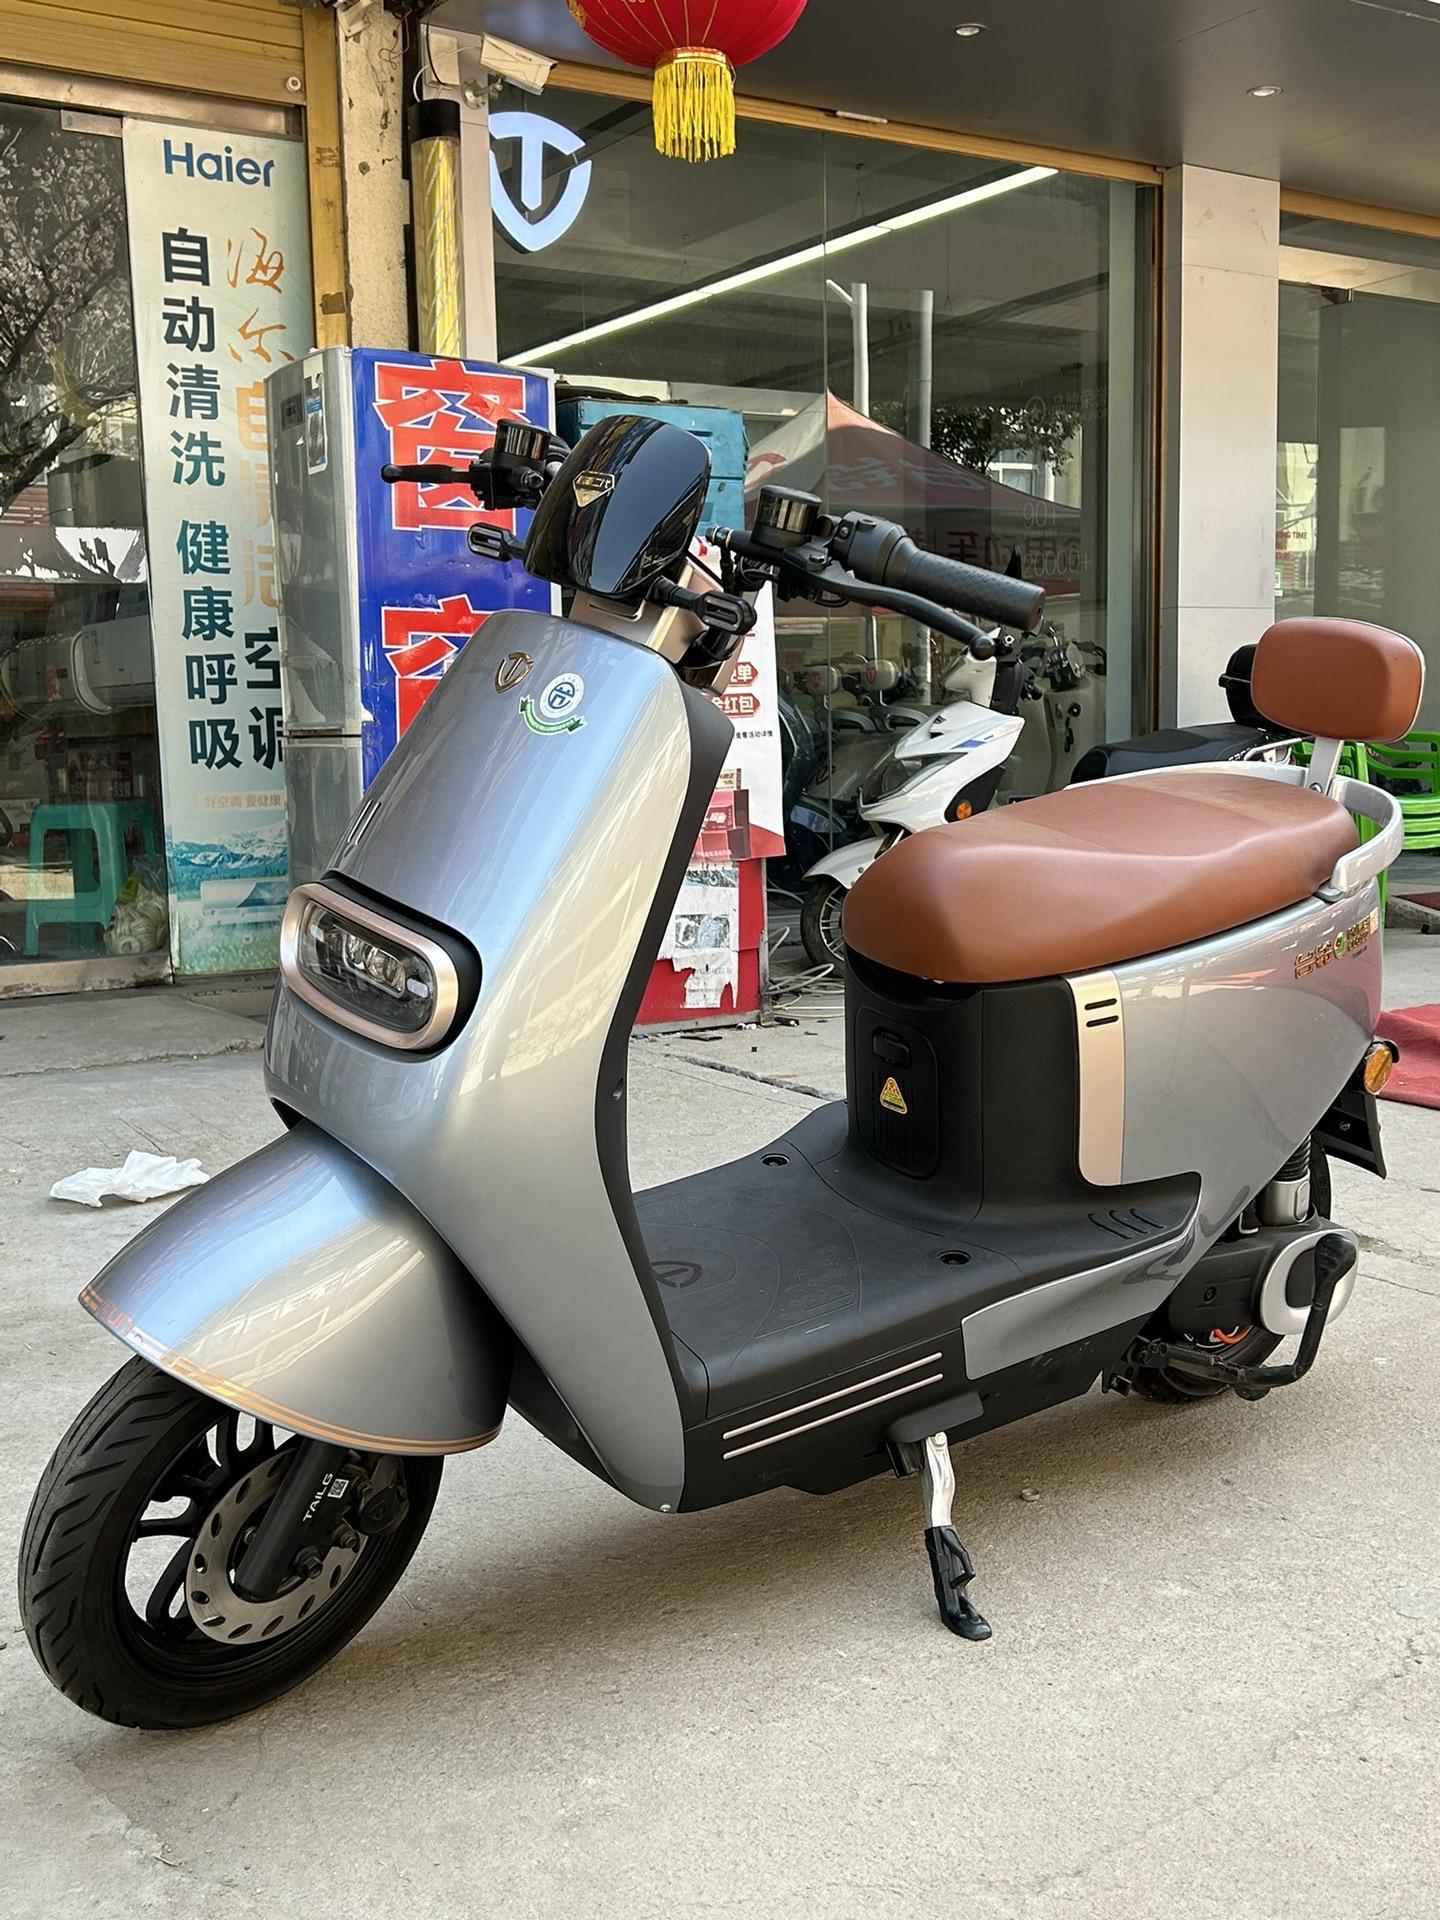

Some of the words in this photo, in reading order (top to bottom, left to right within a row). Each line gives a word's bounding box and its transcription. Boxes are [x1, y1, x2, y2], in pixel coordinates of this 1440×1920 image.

[163, 138, 275, 188] Haier
[226, 226, 295, 363] 海尔
[161, 226, 226, 487] 自动清洗
[176, 519, 242, 770] 健康呼吸
[730, 663, 753, 682] 单
[302, 1472, 334, 1522] TAILG
